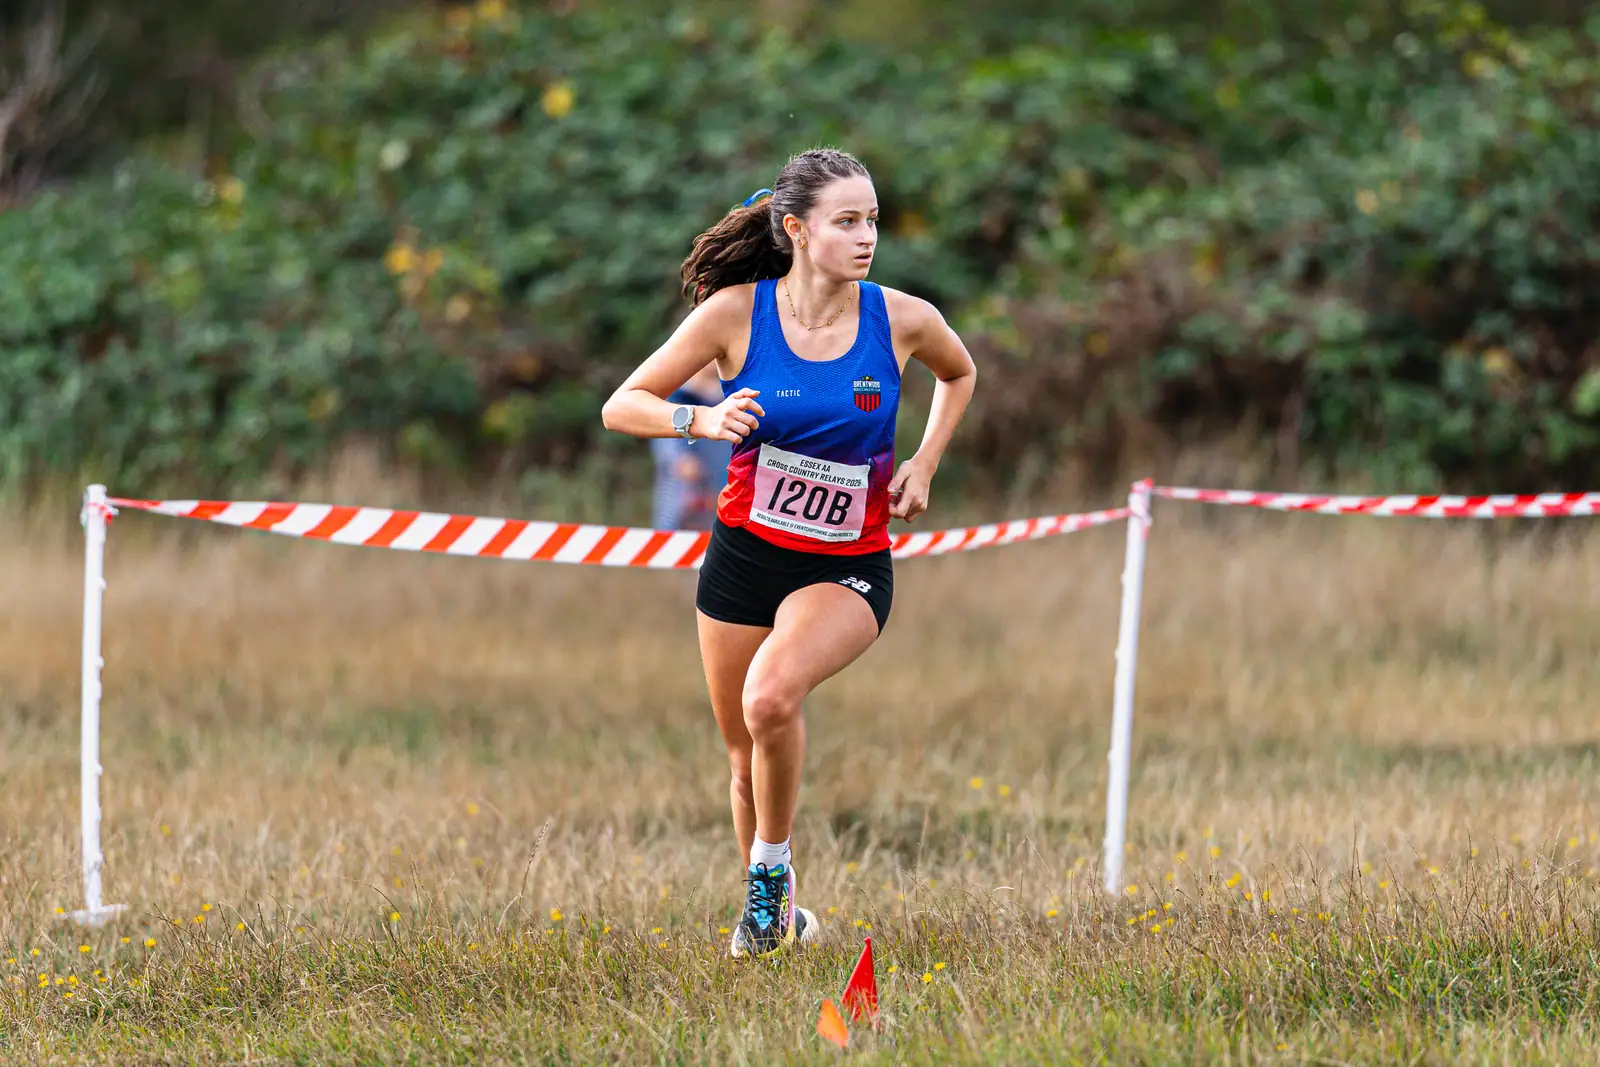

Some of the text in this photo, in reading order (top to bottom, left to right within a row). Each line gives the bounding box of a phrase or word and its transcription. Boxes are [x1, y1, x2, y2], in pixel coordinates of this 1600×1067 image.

[776, 389, 801, 398] TACTIC
[766, 458, 788, 472] CROSS
[788, 465, 820, 480] COUNTRY
[820, 473, 846, 485] RELAYS
[800, 459, 831, 473] ESSEX AA
[767, 476, 853, 526] 120B
[769, 518, 790, 528] AVAILABLE
